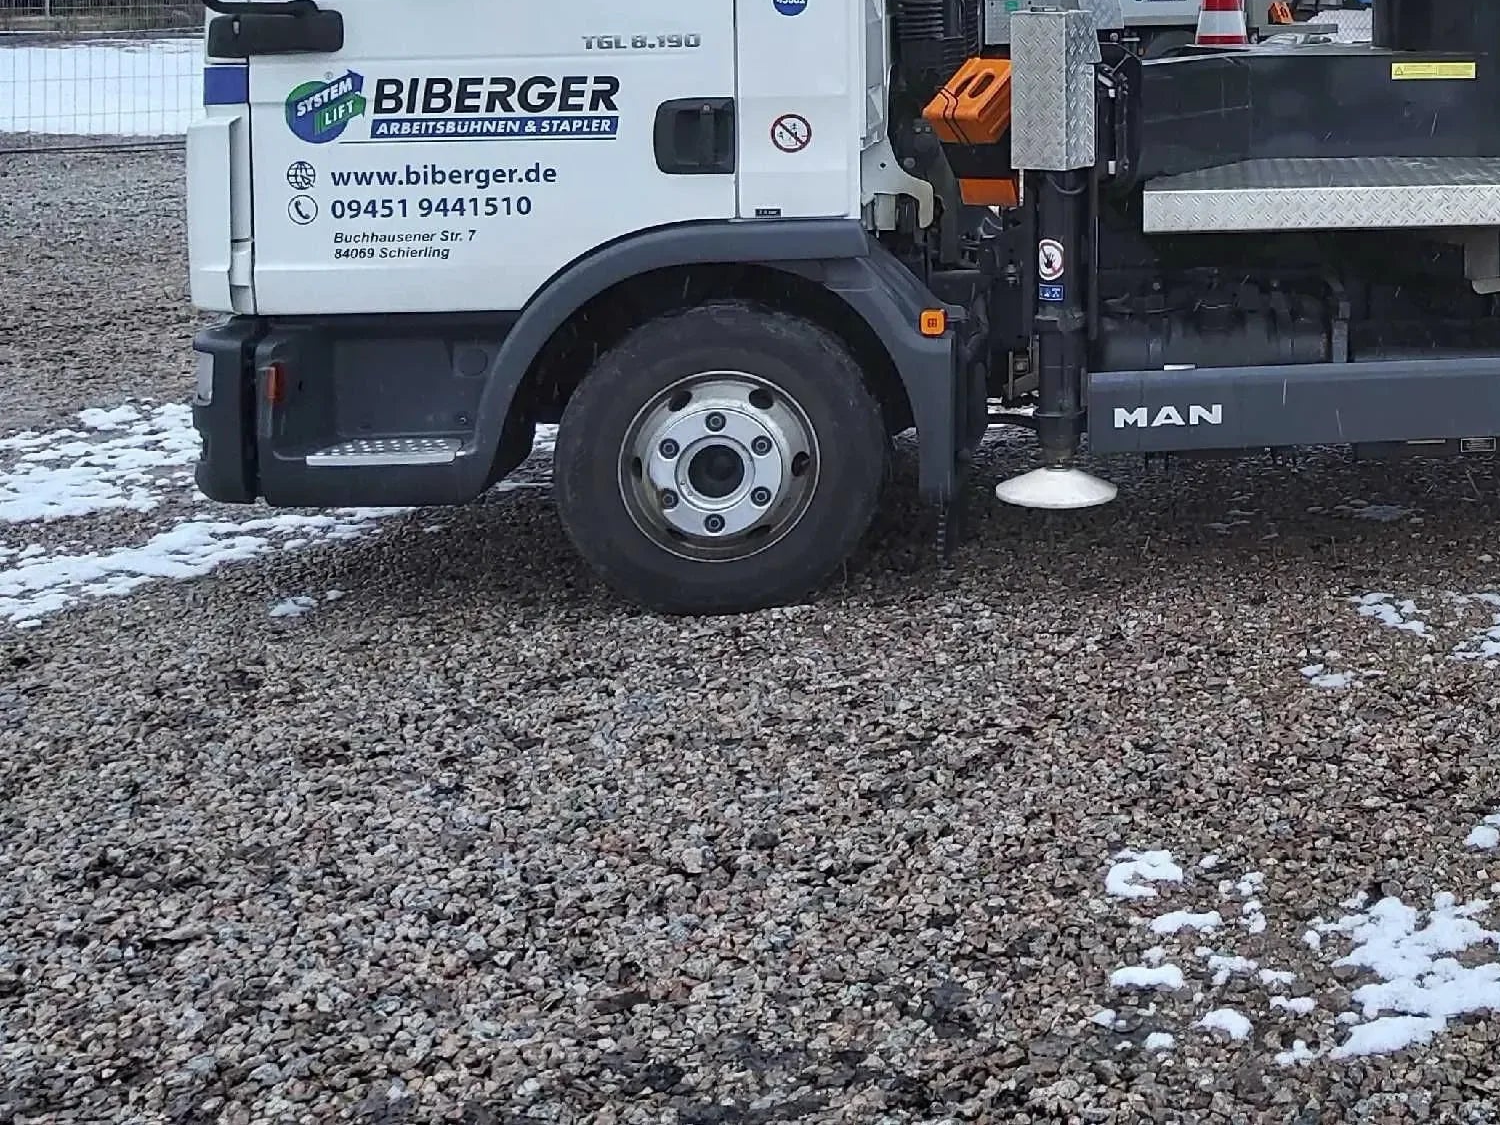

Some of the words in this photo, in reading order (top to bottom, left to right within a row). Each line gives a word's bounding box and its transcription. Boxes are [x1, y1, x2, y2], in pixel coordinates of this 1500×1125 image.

[582, 34, 627, 50] TGL
[631, 32, 701, 49] 8.190
[297, 77, 353, 117] SYSTEM
[373, 76, 620, 115] BIBERGER
[324, 99, 355, 125] LIFT
[524, 119, 537, 133] &
[540, 118, 612, 133] STAPLER
[330, 162, 558, 189] www.biberger.de
[330, 199, 408, 219] 09451
[417, 196, 532, 217] 9441510
[333, 231, 436, 244] Buchhausener
[439, 230, 463, 242] Str.
[467, 229, 477, 241] 7
[334, 248, 375, 259] 84069
[378, 245, 450, 260] Schierling
[1113, 403, 1224, 428] MAN
